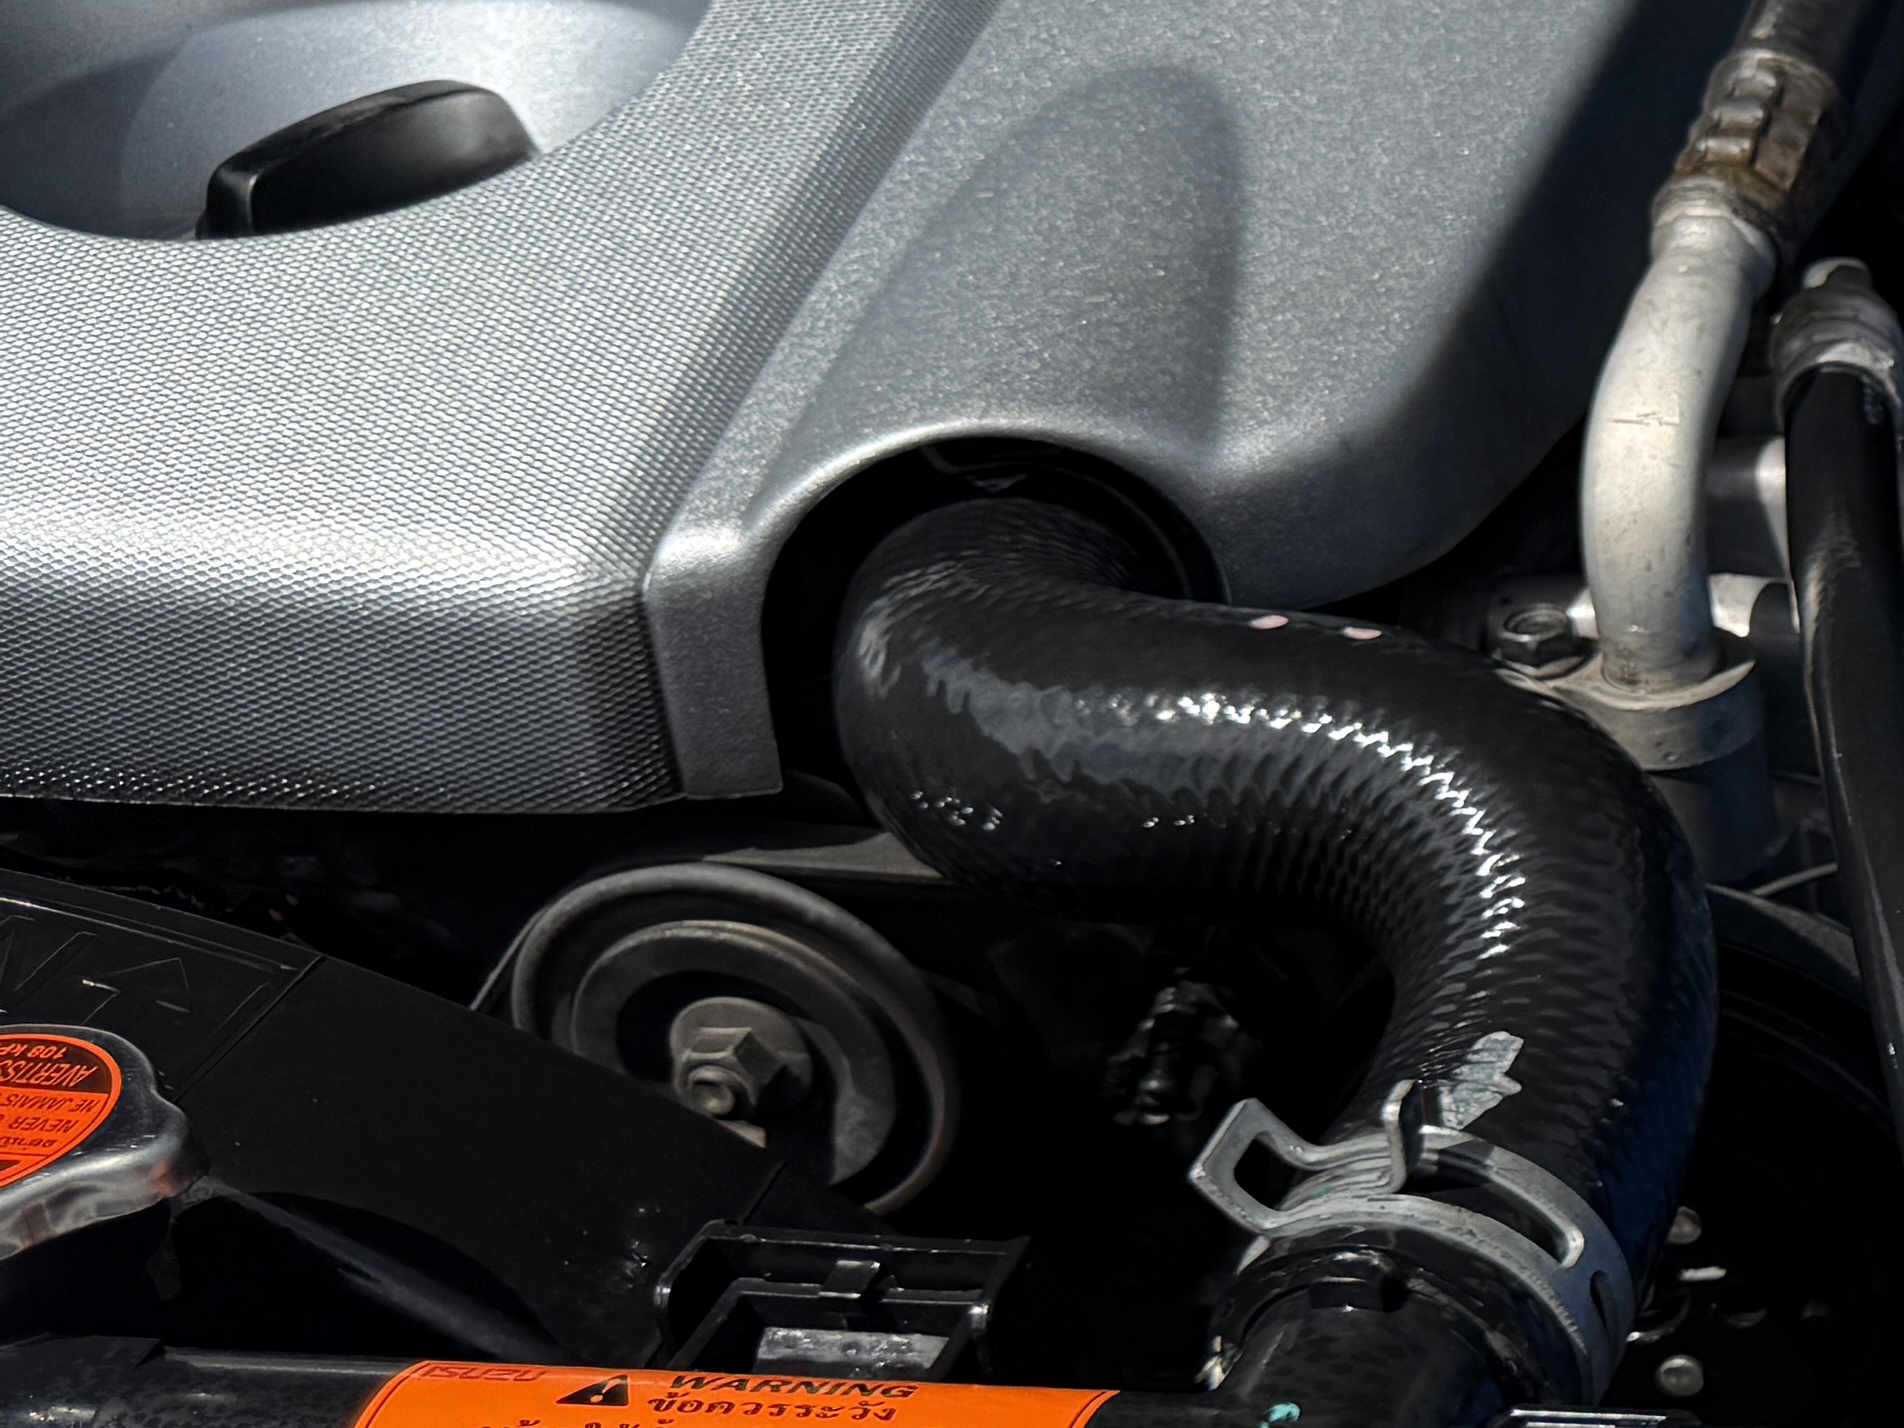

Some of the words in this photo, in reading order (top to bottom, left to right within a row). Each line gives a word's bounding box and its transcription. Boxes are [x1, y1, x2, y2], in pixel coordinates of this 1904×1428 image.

[0, 1043, 26, 1056] kP
[27, 1045, 67, 1059] 108
[8, 1115, 80, 1134] NEVER
[671, 1373, 920, 1399] WARNING
[646, 1391, 897, 1422] ข้อควรระวัง
